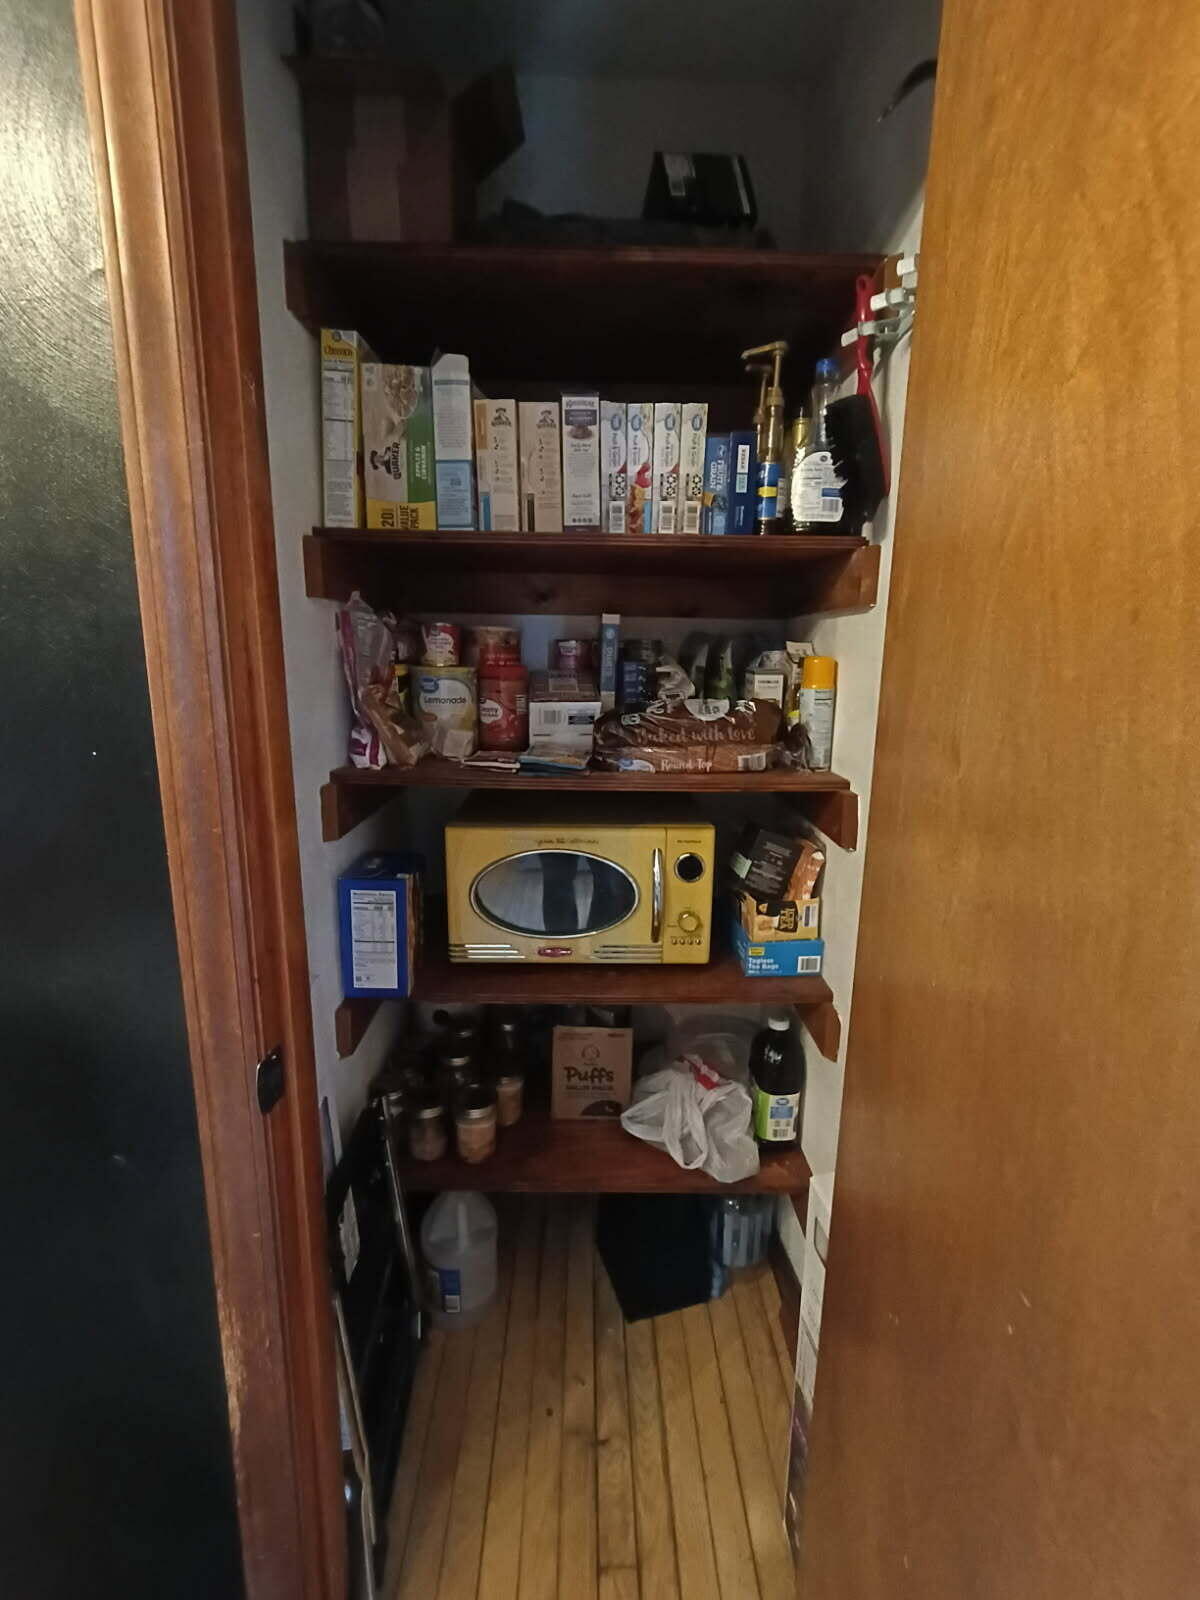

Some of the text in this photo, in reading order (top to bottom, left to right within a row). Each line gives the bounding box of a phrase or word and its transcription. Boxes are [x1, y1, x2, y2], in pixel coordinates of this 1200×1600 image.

[391, 441, 402, 480] QUAKER
[399, 505, 409, 531] VALUE
[410, 507, 419, 529] PACK
[424, 696, 467, 705] Lemonade
[690, 726, 724, 742] with
[728, 725, 756, 741] love
[660, 759, 713, 772] Round Top
[563, 1065, 614, 1083] Puffs
